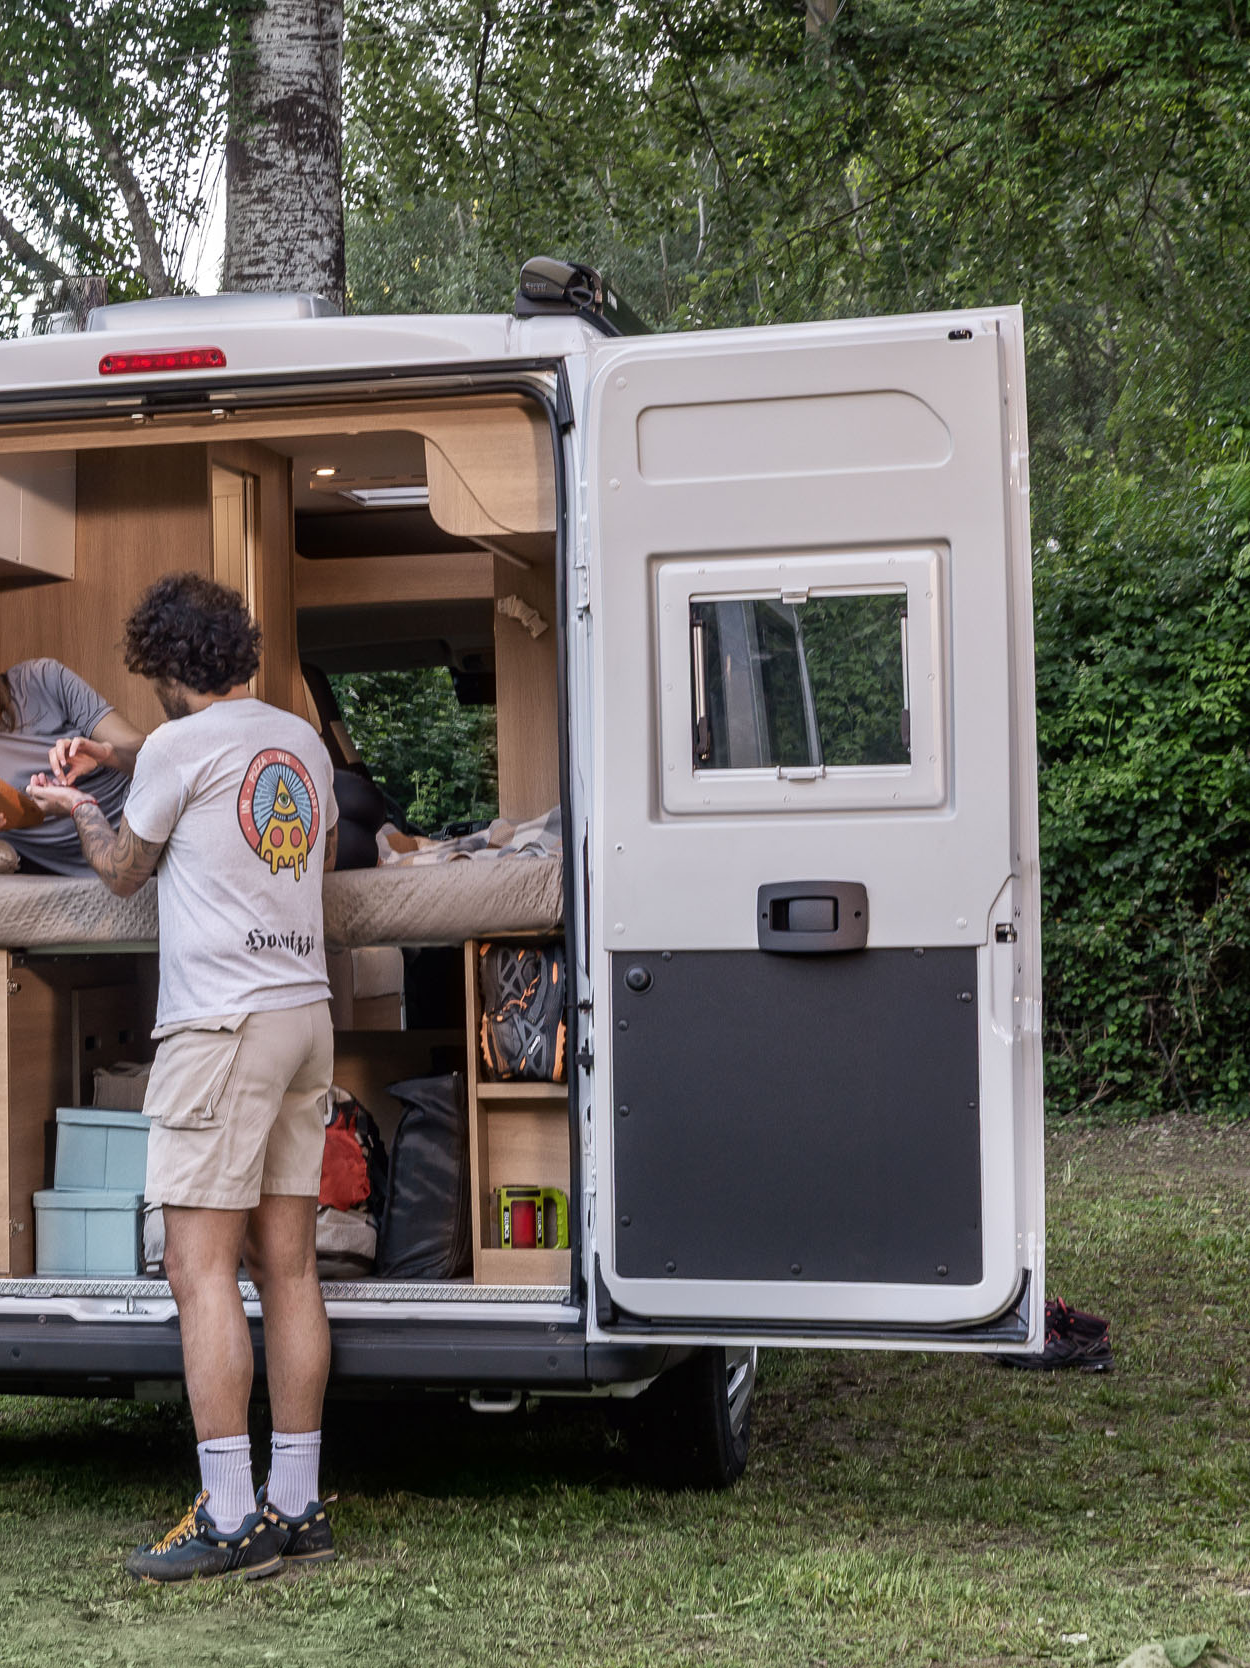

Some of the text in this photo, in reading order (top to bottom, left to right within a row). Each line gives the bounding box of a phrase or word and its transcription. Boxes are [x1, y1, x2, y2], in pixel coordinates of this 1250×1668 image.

[241, 751, 319, 815] IN PIZZA WE TRUST
